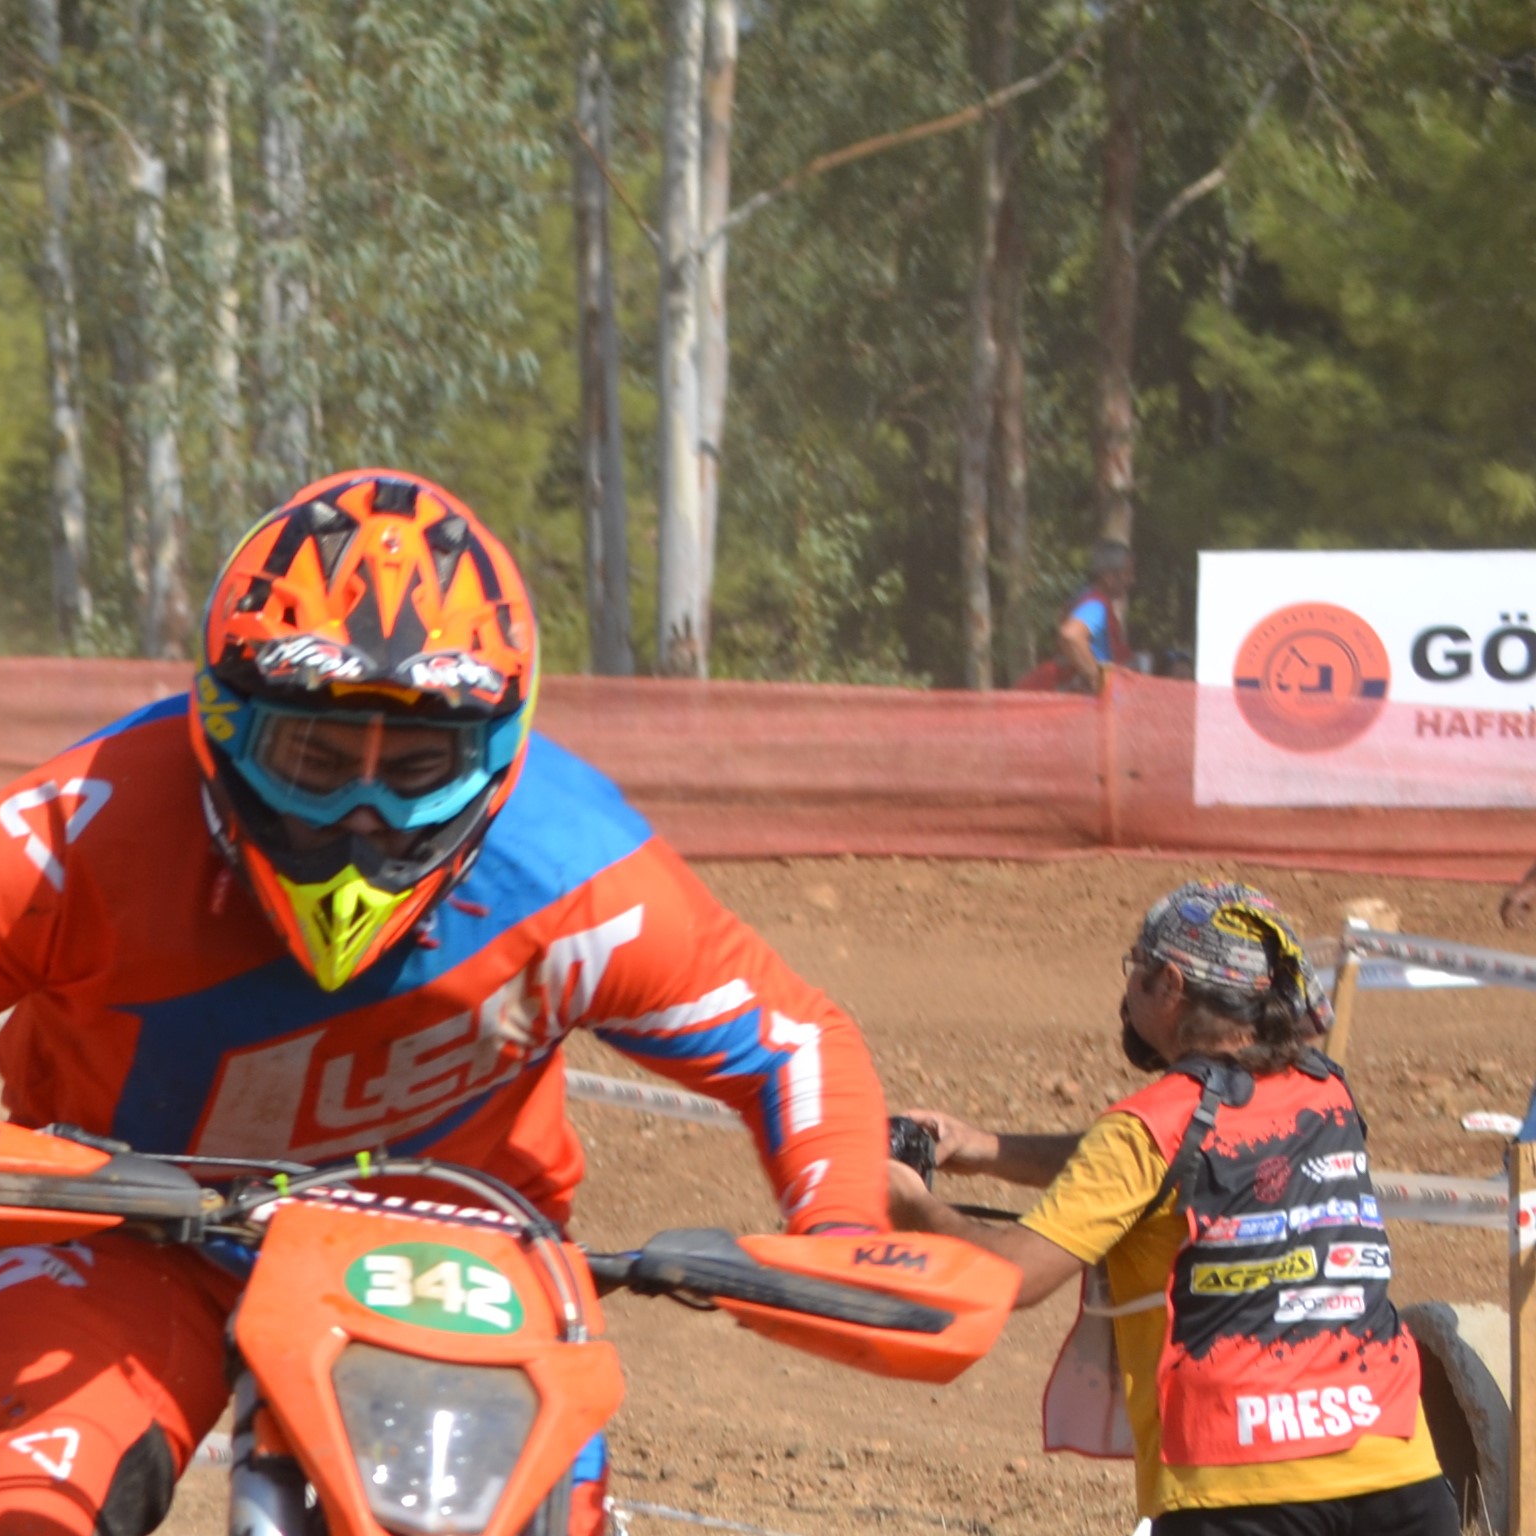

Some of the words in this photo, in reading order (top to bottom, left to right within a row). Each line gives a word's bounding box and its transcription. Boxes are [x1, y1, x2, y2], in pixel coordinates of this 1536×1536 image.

[851, 1243, 929, 1272] KTM
[363, 1254, 513, 1330] 342
[1236, 1384, 1382, 1446] PRESS
